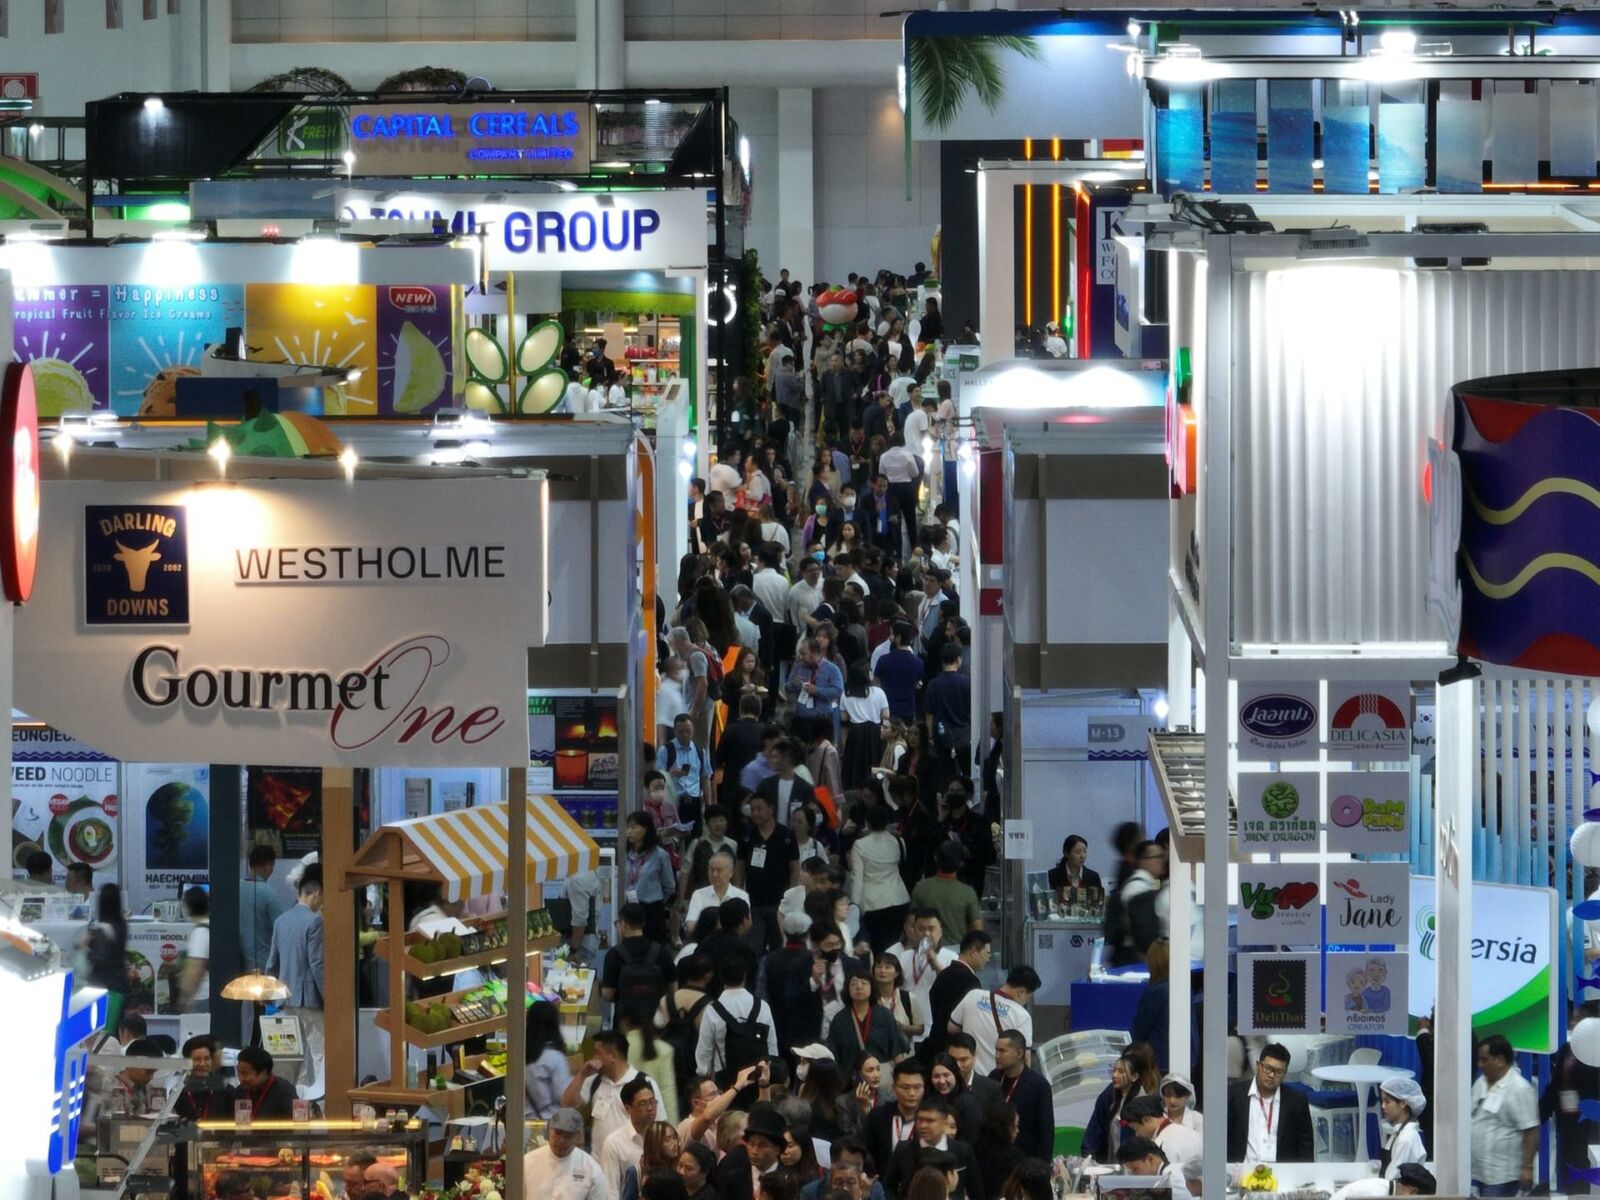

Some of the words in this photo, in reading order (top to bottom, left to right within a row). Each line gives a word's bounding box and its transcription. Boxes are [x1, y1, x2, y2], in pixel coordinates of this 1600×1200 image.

[352, 112, 455, 140] CAPITAL
[469, 112, 580, 138] CEREALS
[504, 208, 660, 254] GROUP
[115, 284, 220, 306] Happiness
[395, 292, 432, 304] NEW!
[62, 307, 94, 319] Fruit
[100, 512, 177, 538] DARLING
[235, 546, 506, 579] WESTHOLME
[107, 598, 169, 616] DOWNS
[132, 645, 391, 711] Gourmet
[330, 635, 505, 750] One
[1091, 727, 1120, 738] M-13
[1331, 729, 1406, 741] DELICASIA
[51, 767, 113, 783] NOODLE
[1370, 894, 1396, 906] Lady
[1339, 897, 1403, 929] Jane
[1347, 1023, 1385, 1032] CREATOR
